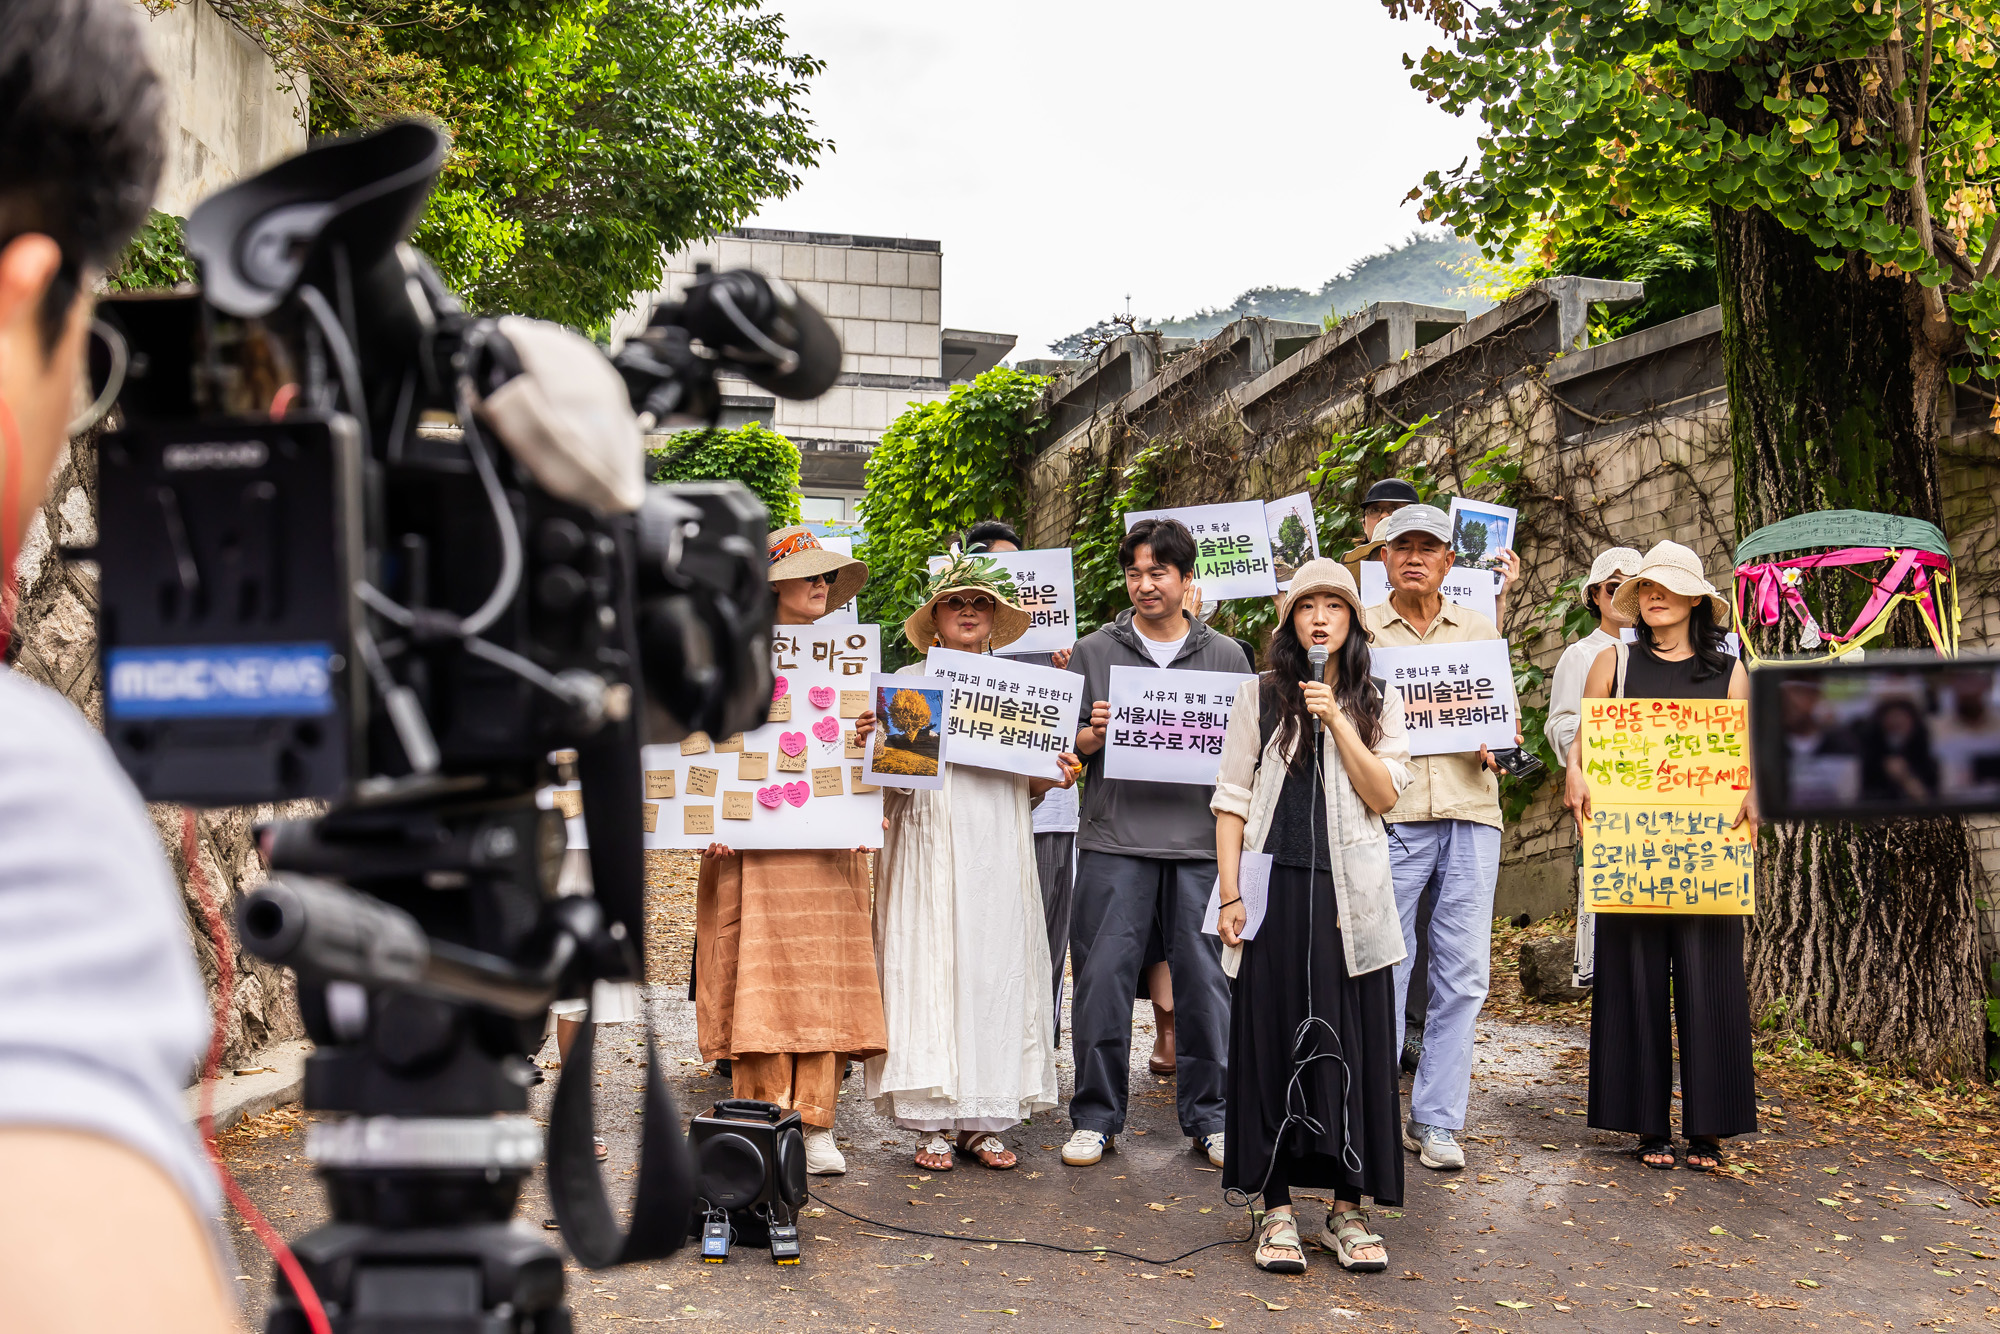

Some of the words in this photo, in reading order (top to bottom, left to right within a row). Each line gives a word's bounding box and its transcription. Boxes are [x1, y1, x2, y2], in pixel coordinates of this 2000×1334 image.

[1211, 522, 1230, 532] 독살
[1016, 571, 1036, 582] 독살
[1204, 557, 1268, 578] 사과하라
[1016, 584, 1058, 606] 관은
[1439, 586, 1472, 596] 인했다
[812, 634, 868, 676] 마음
[1394, 666, 1441, 679] 은행나무
[1447, 664, 1470, 675] 독살
[934, 668, 980, 686] 생명파괴
[986, 678, 1020, 694] 미술관
[1026, 685, 1074, 703] 규탄한다
[1143, 690, 1177, 702] 사유지
[1184, 692, 1206, 704] 핑계
[1114, 706, 1176, 726] 서울시는
[1438, 704, 1509, 728] 복원하라
[1588, 702, 1644, 733] 부암동
[998, 725, 1070, 752] 살려내라
[1112, 729, 1184, 750] 보호수로
[1188, 734, 1225, 754] 지정
[1588, 732, 1658, 758] 나무와
[1664, 733, 1702, 759] 살던
[1706, 732, 1742, 757] 모든
[1656, 759, 1750, 798] 살아주세요
[1590, 810, 1630, 838] 우리
[1590, 842, 1636, 869] 오래
[1590, 866, 1750, 907] 은행나무입니다!
